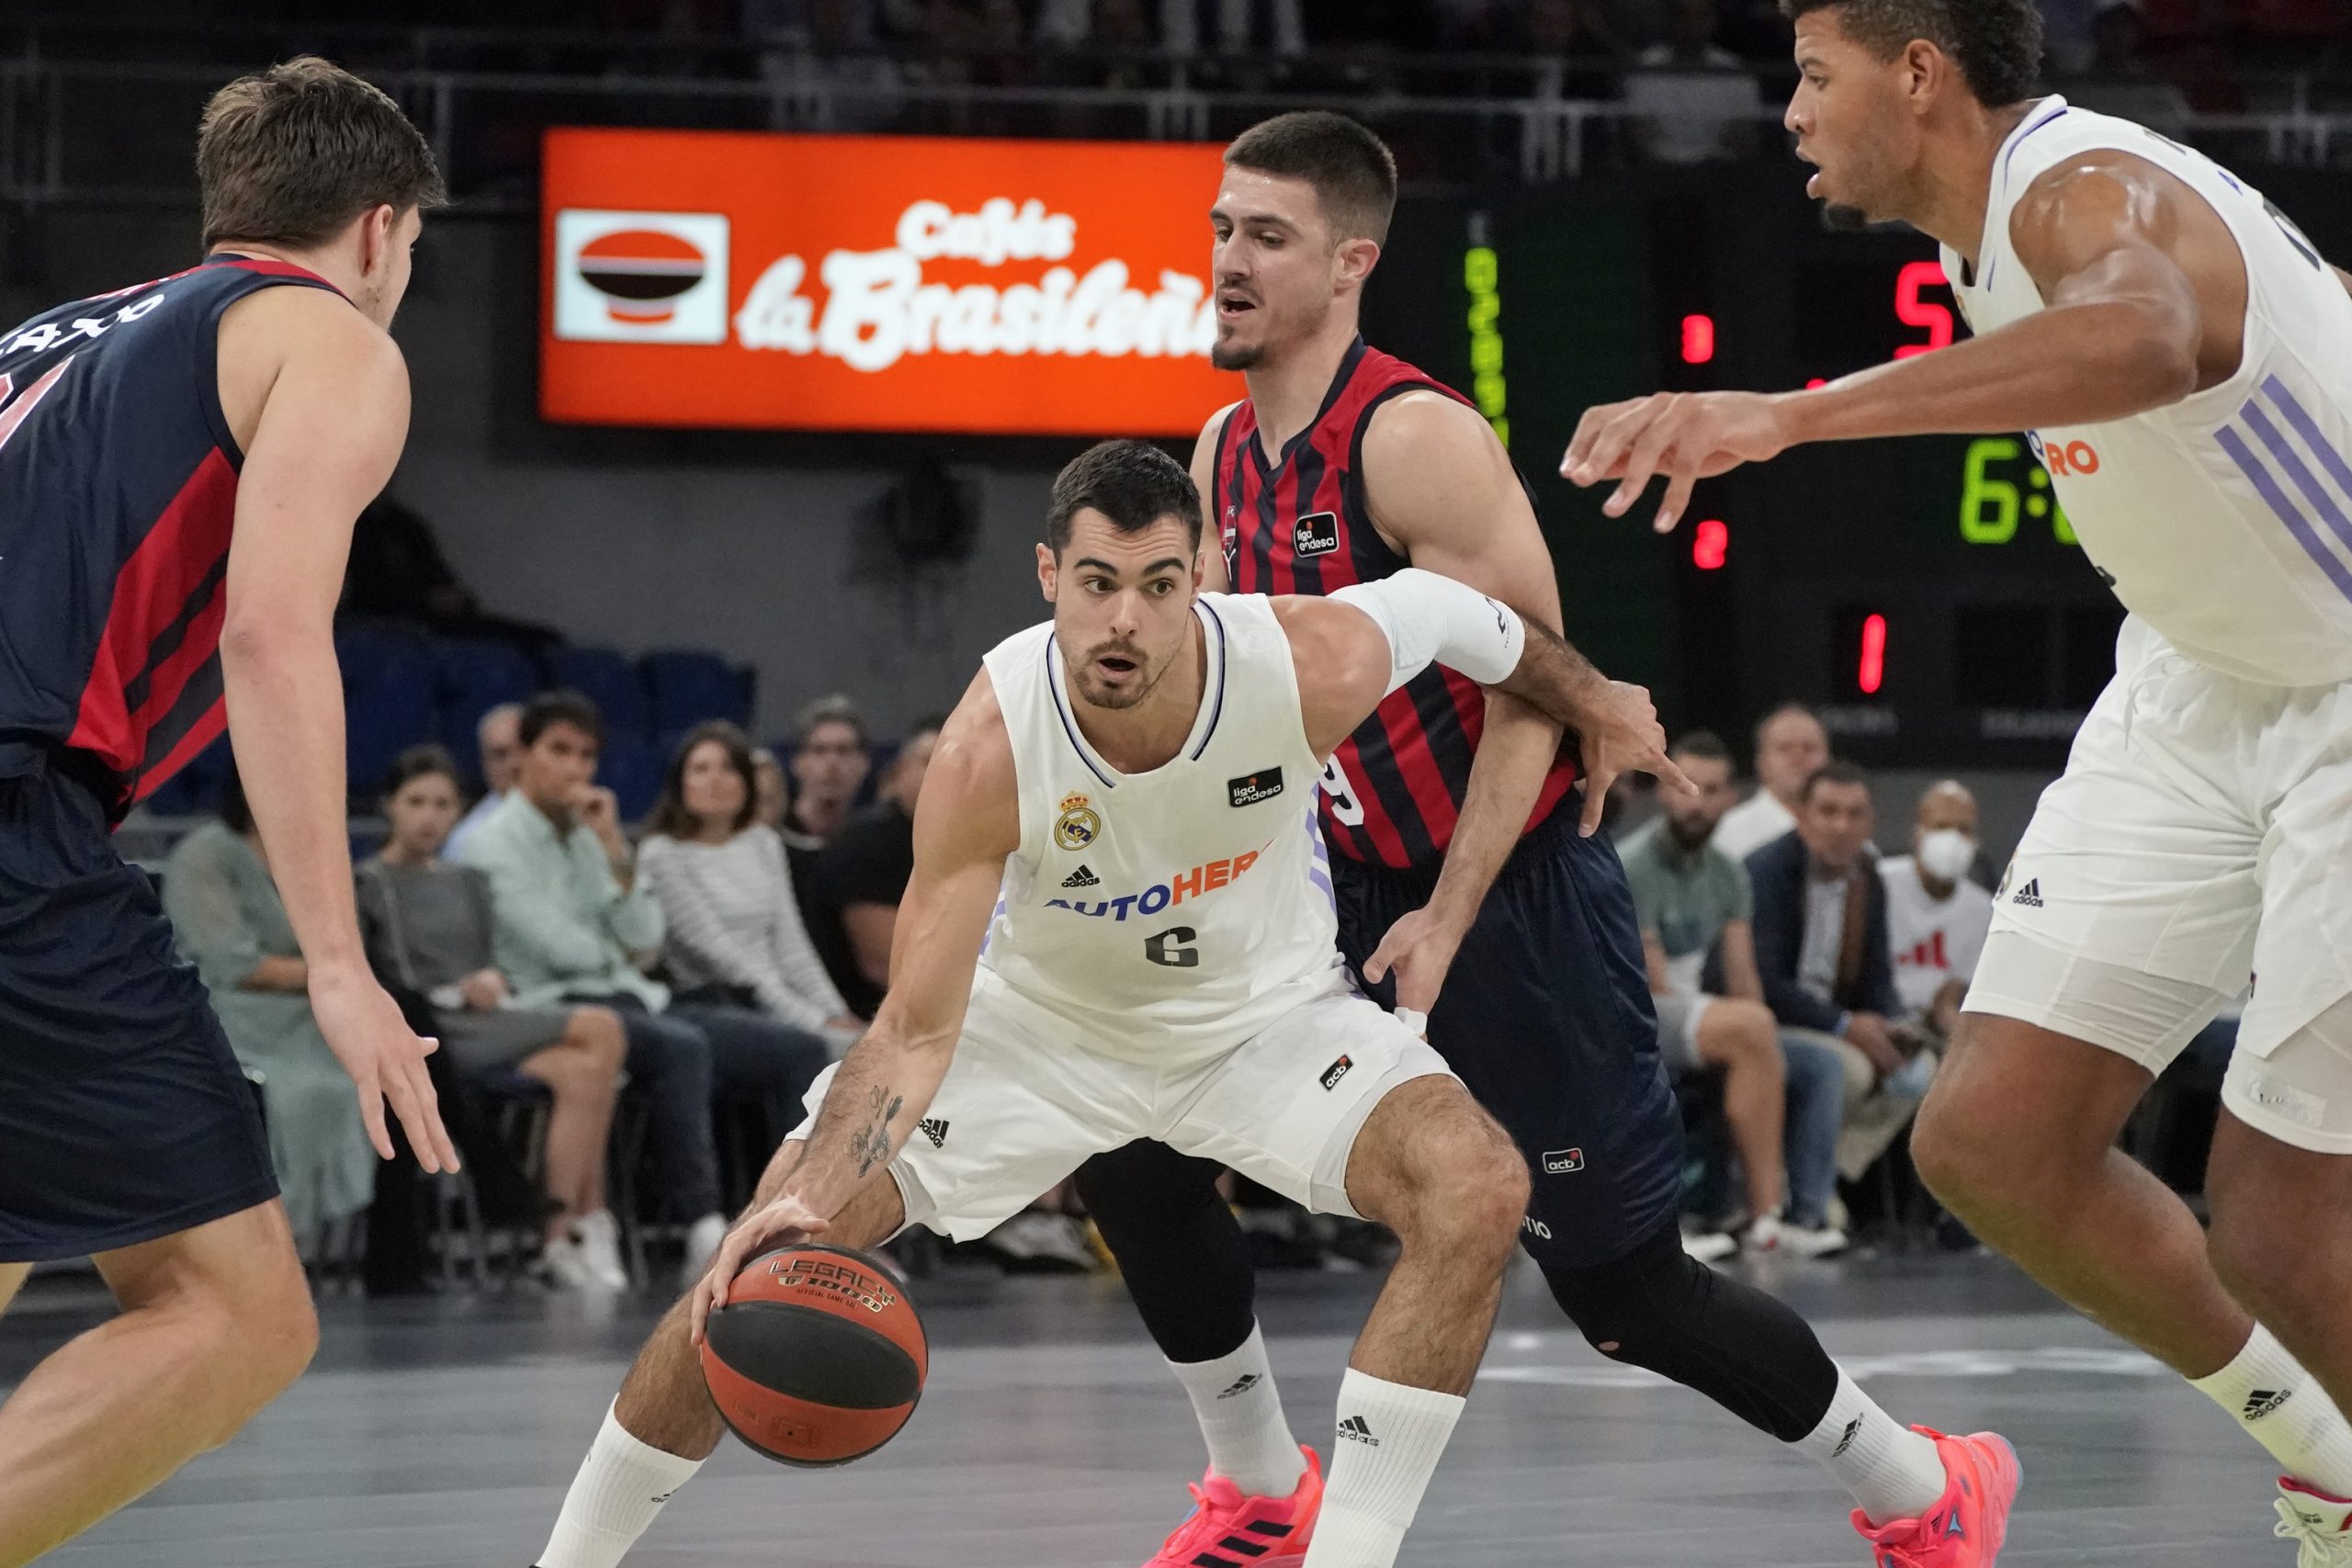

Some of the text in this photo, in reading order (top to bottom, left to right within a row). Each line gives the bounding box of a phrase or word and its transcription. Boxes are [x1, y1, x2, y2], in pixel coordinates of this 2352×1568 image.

[896, 197, 1078, 266] Cafés
[737, 254, 820, 355] la
[1960, 436, 2081, 546] 6:
[1296, 529, 1313, 542] liga
[1299, 536, 1335, 551] endesa
[1859, 613, 1886, 694] 1
[1234, 785, 1256, 797] liga
[1235, 784, 1282, 805] endesa
[1043, 837, 1277, 921] AUTOHER
[1061, 876, 1101, 888] adidas
[1326, 1065, 1347, 1088] acb
[1548, 1158, 1575, 1170] acb
[768, 1259, 896, 1306] LEGACY
[2245, 1389, 2292, 1421] adidas
